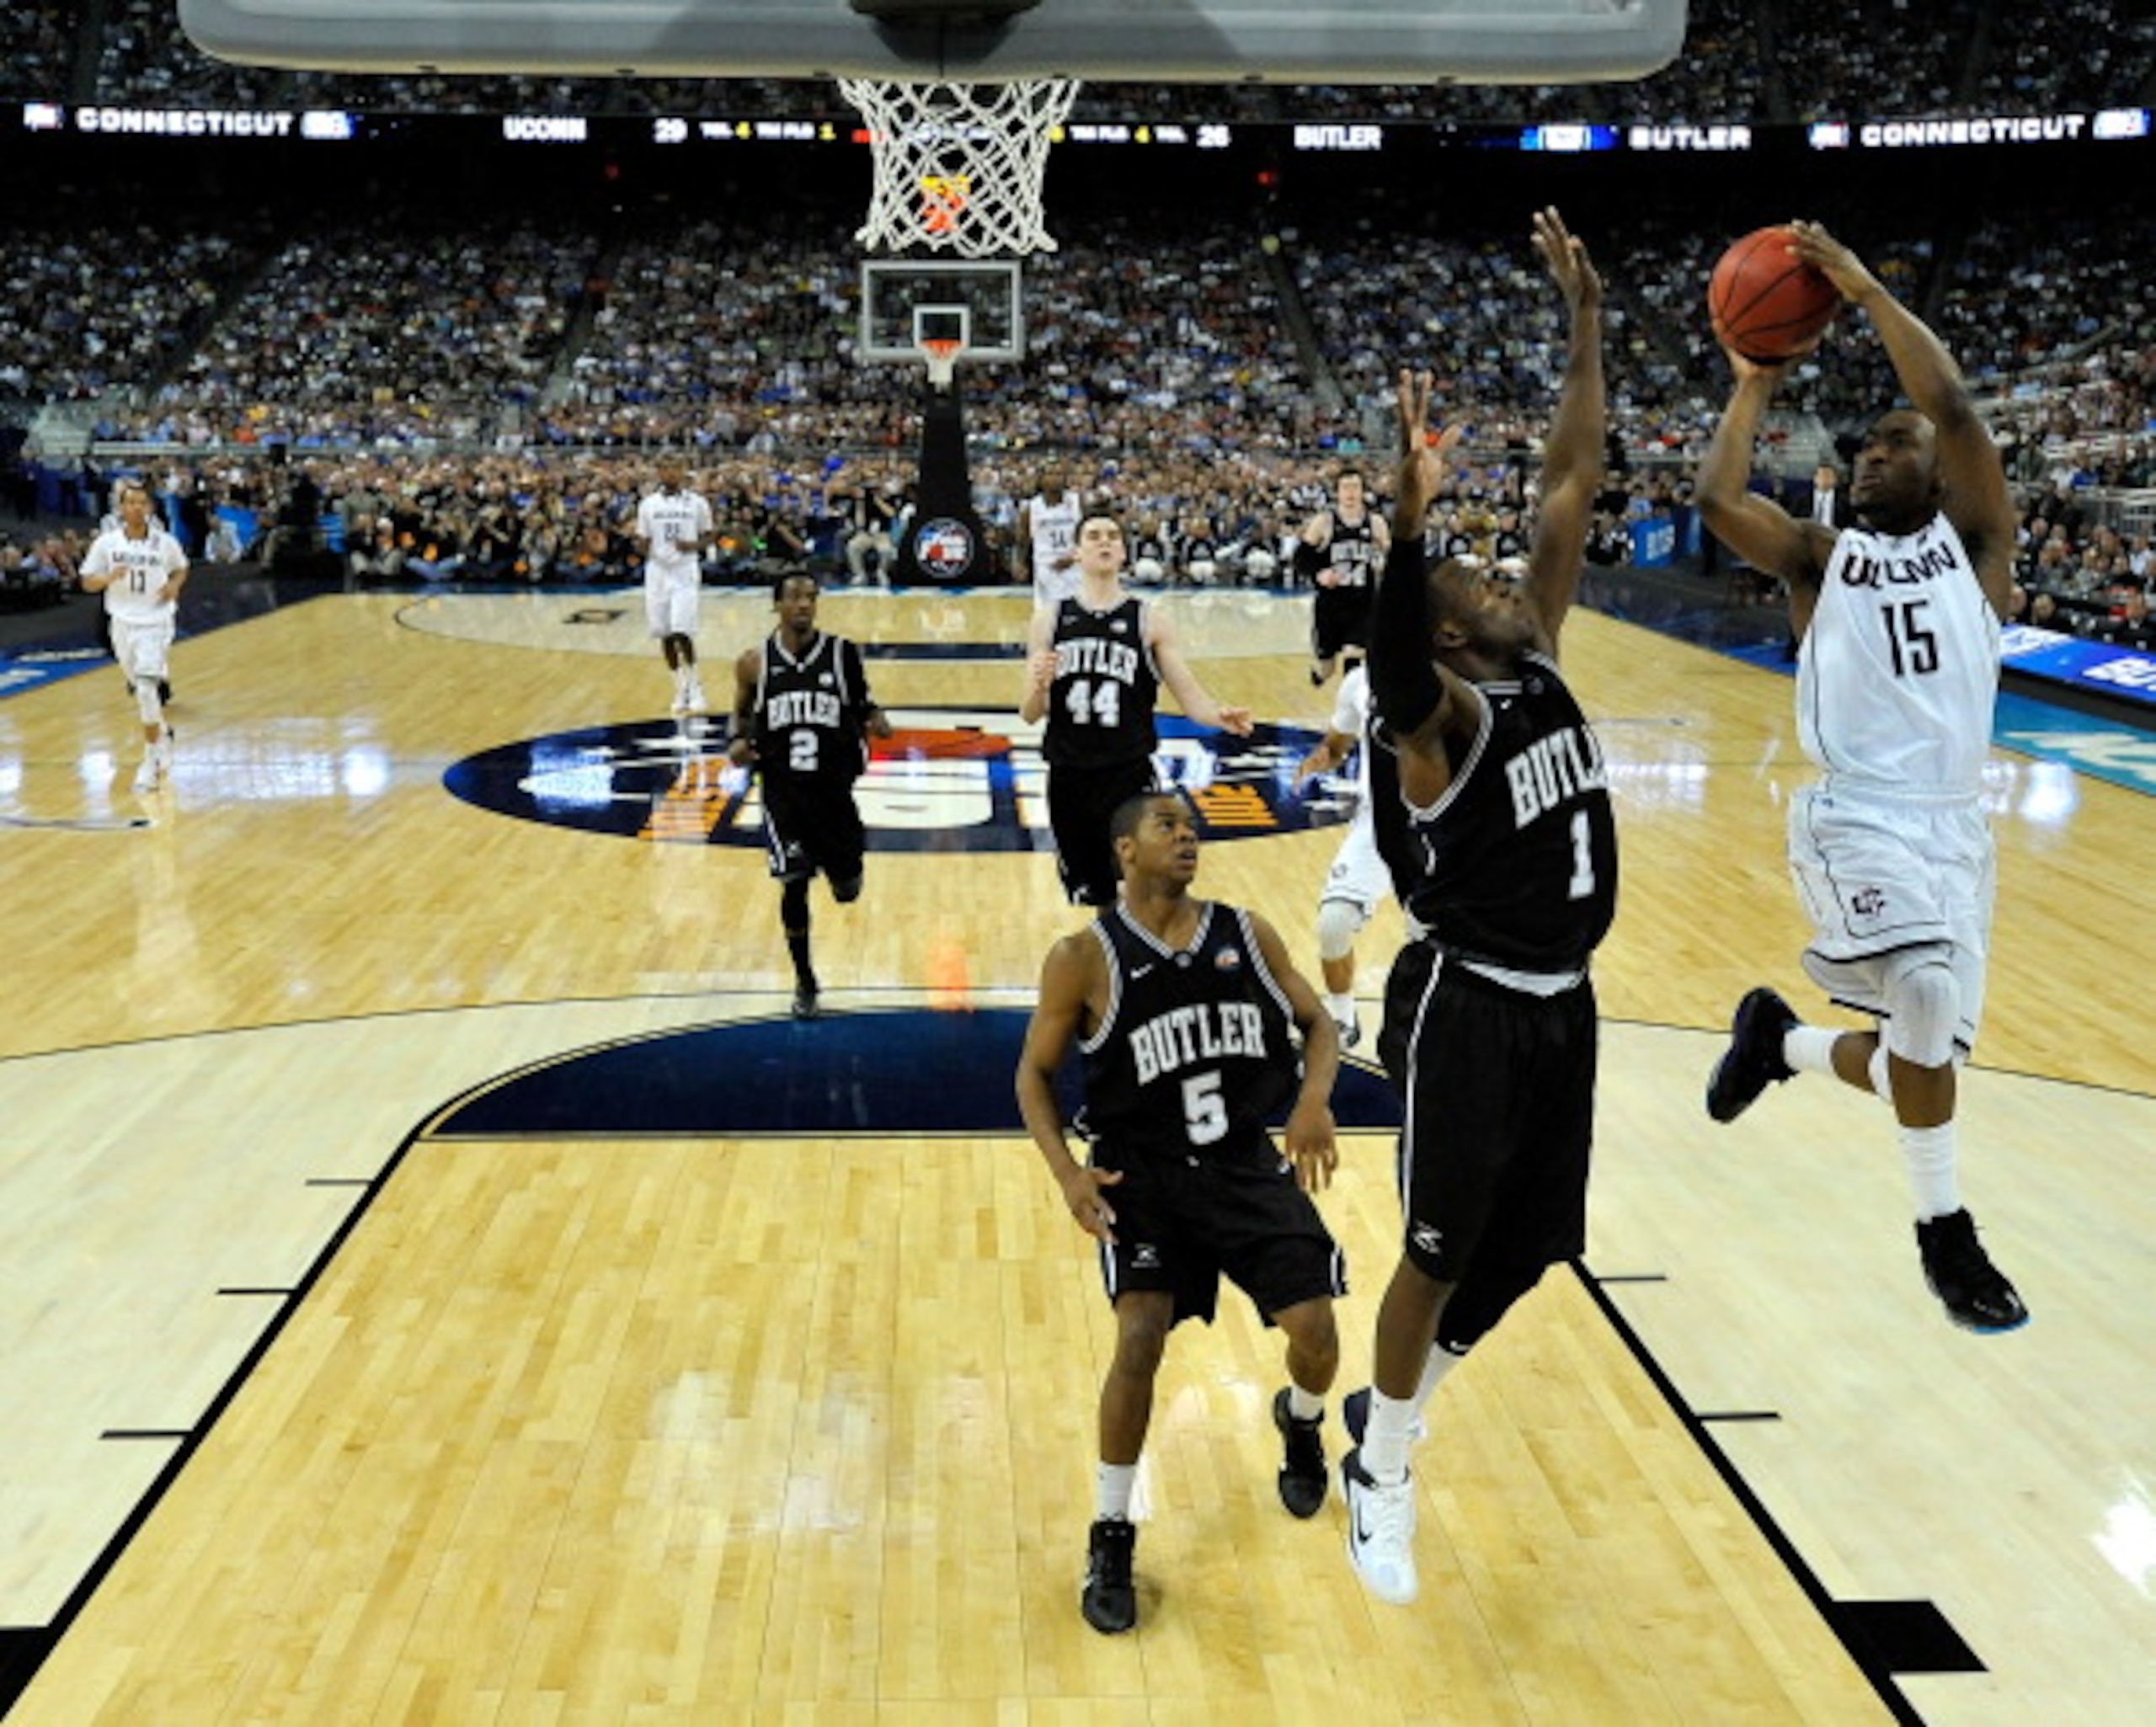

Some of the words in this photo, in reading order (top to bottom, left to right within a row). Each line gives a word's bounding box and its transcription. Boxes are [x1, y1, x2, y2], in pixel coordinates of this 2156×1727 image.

[76, 107, 294, 136] CONNECTICUT
[503, 117, 588, 141] UCONN
[1293, 124, 1382, 151] BUTLER
[1628, 125, 1752, 151] BUTLER
[1860, 114, 2085, 147] CONNECTICUT
[1881, 599, 1940, 679] 15
[767, 690, 841, 732] BUTLER
[1065, 678, 1121, 728] 44
[788, 728, 819, 772] 2
[1503, 726, 1609, 831] BUTL
[1566, 808, 1596, 901] 1
[1128, 1000, 1267, 1086] BUTLER
[1181, 1068, 1230, 1146] 5
